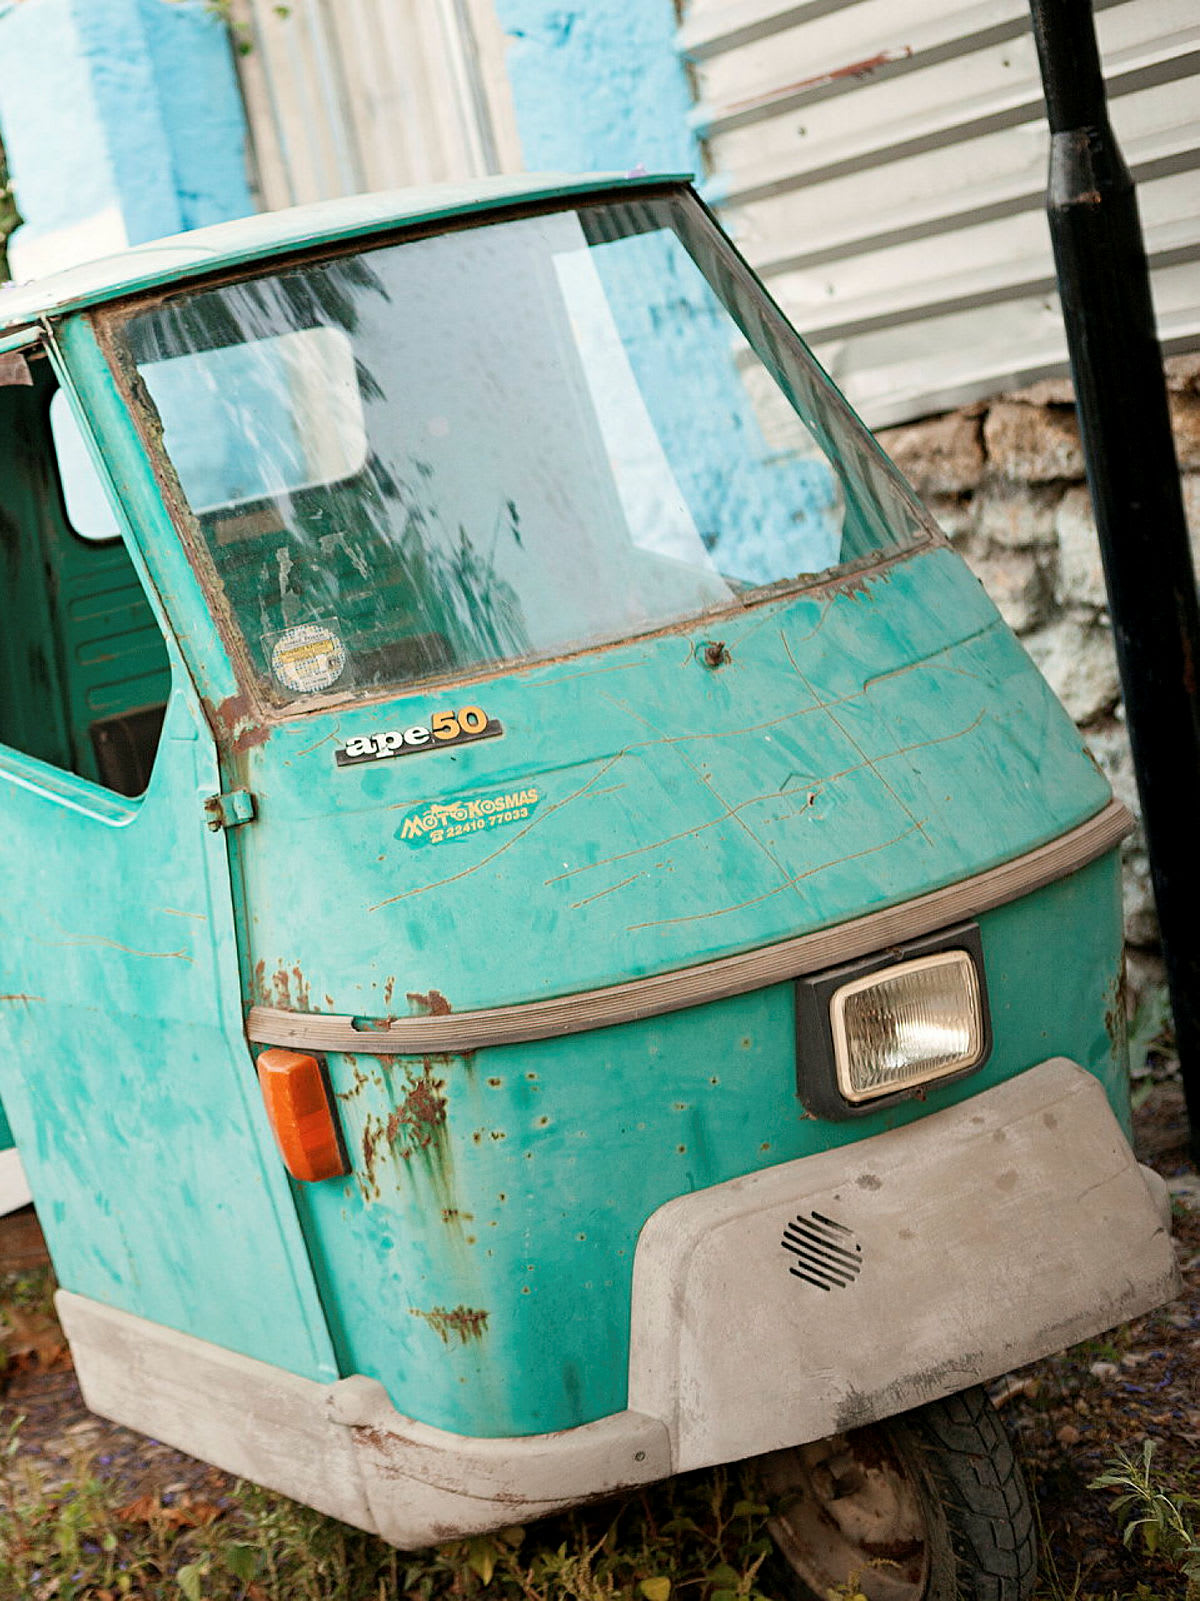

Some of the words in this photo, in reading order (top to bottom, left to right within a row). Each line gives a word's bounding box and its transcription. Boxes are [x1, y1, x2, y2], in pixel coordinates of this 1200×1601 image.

[345, 706, 488, 758] ape50
[446, 819, 486, 838] 22410
[488, 807, 529, 826] 77033
